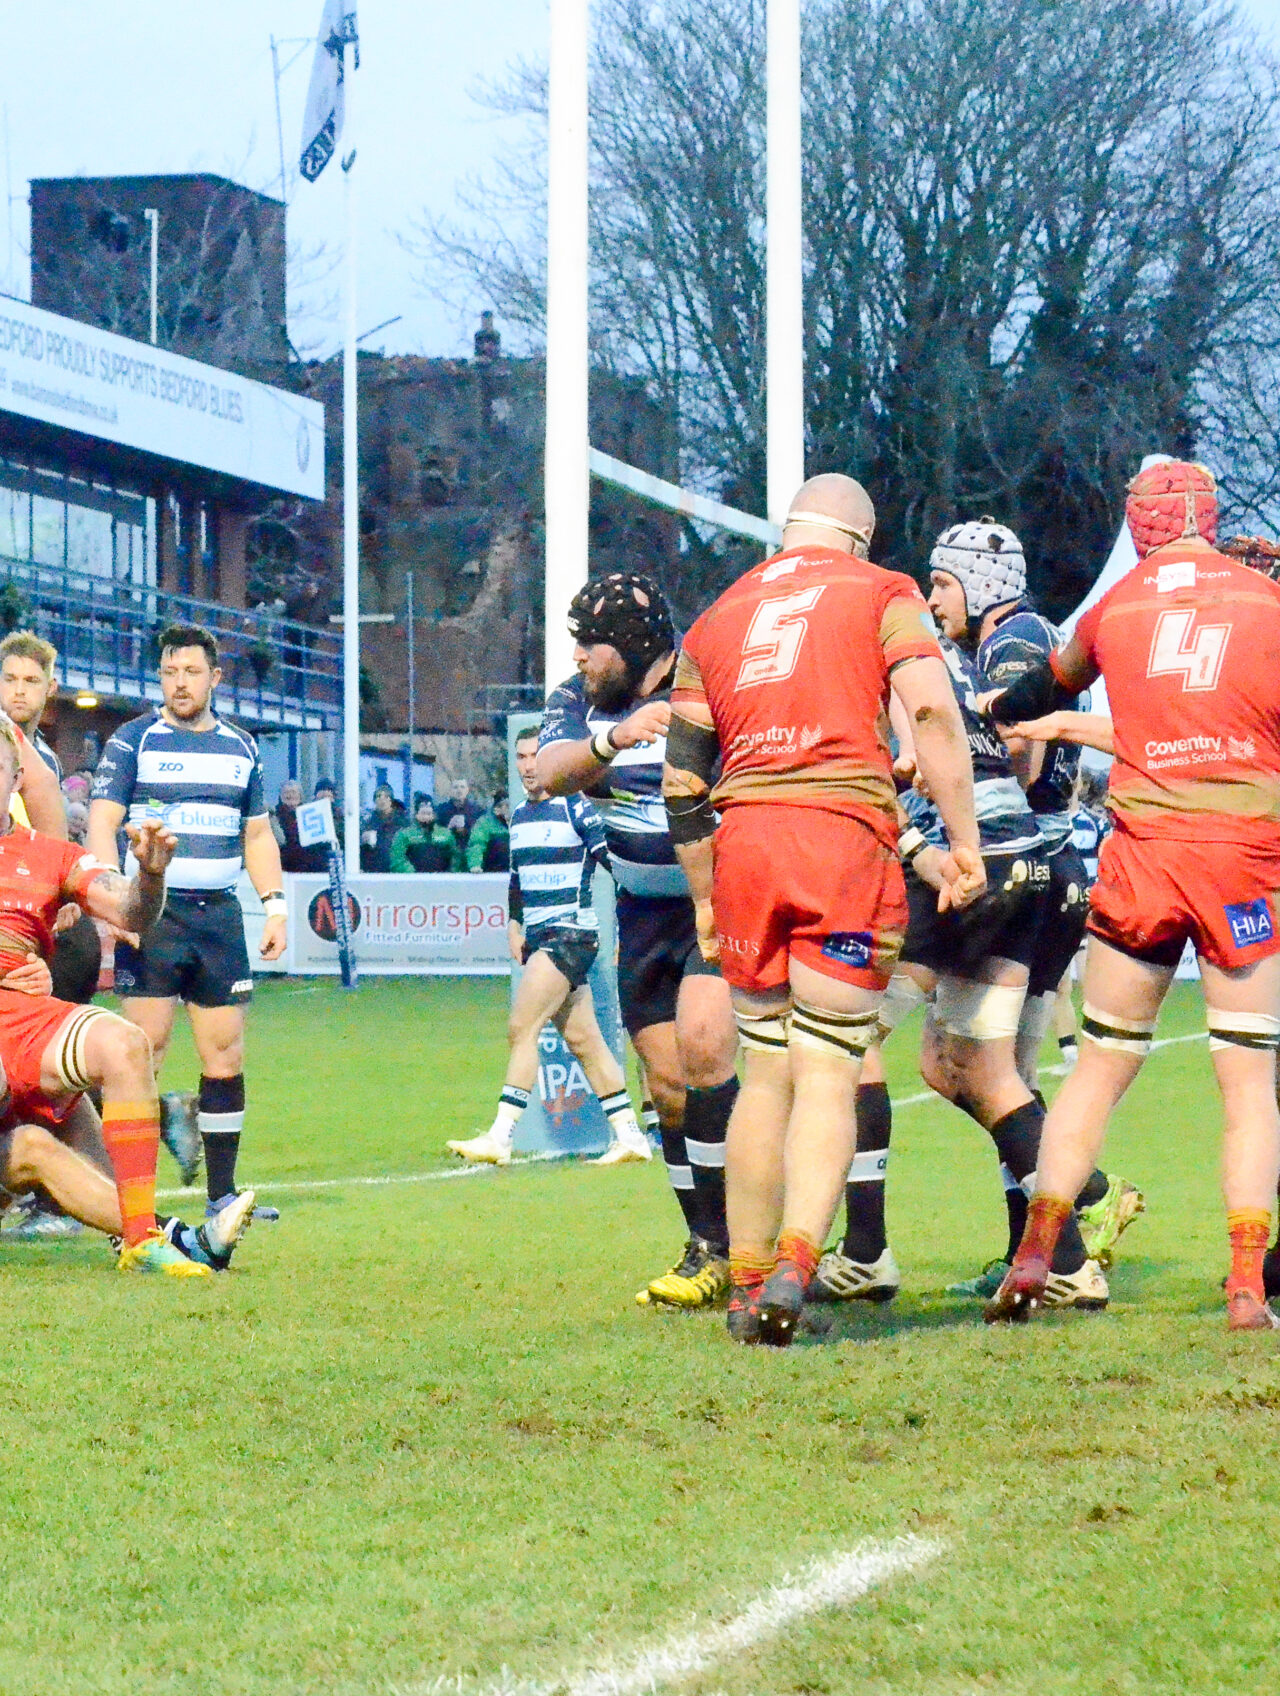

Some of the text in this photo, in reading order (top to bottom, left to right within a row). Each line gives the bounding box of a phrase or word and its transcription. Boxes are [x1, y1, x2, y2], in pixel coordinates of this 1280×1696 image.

[733, 584, 827, 693] 5
[1147, 608, 1233, 693] 4
[1144, 735, 1222, 758] Coventry
[1146, 752, 1227, 770] Business School
[365, 931, 462, 943] Fitted Furniture
[1232, 914, 1271, 938] HIA
